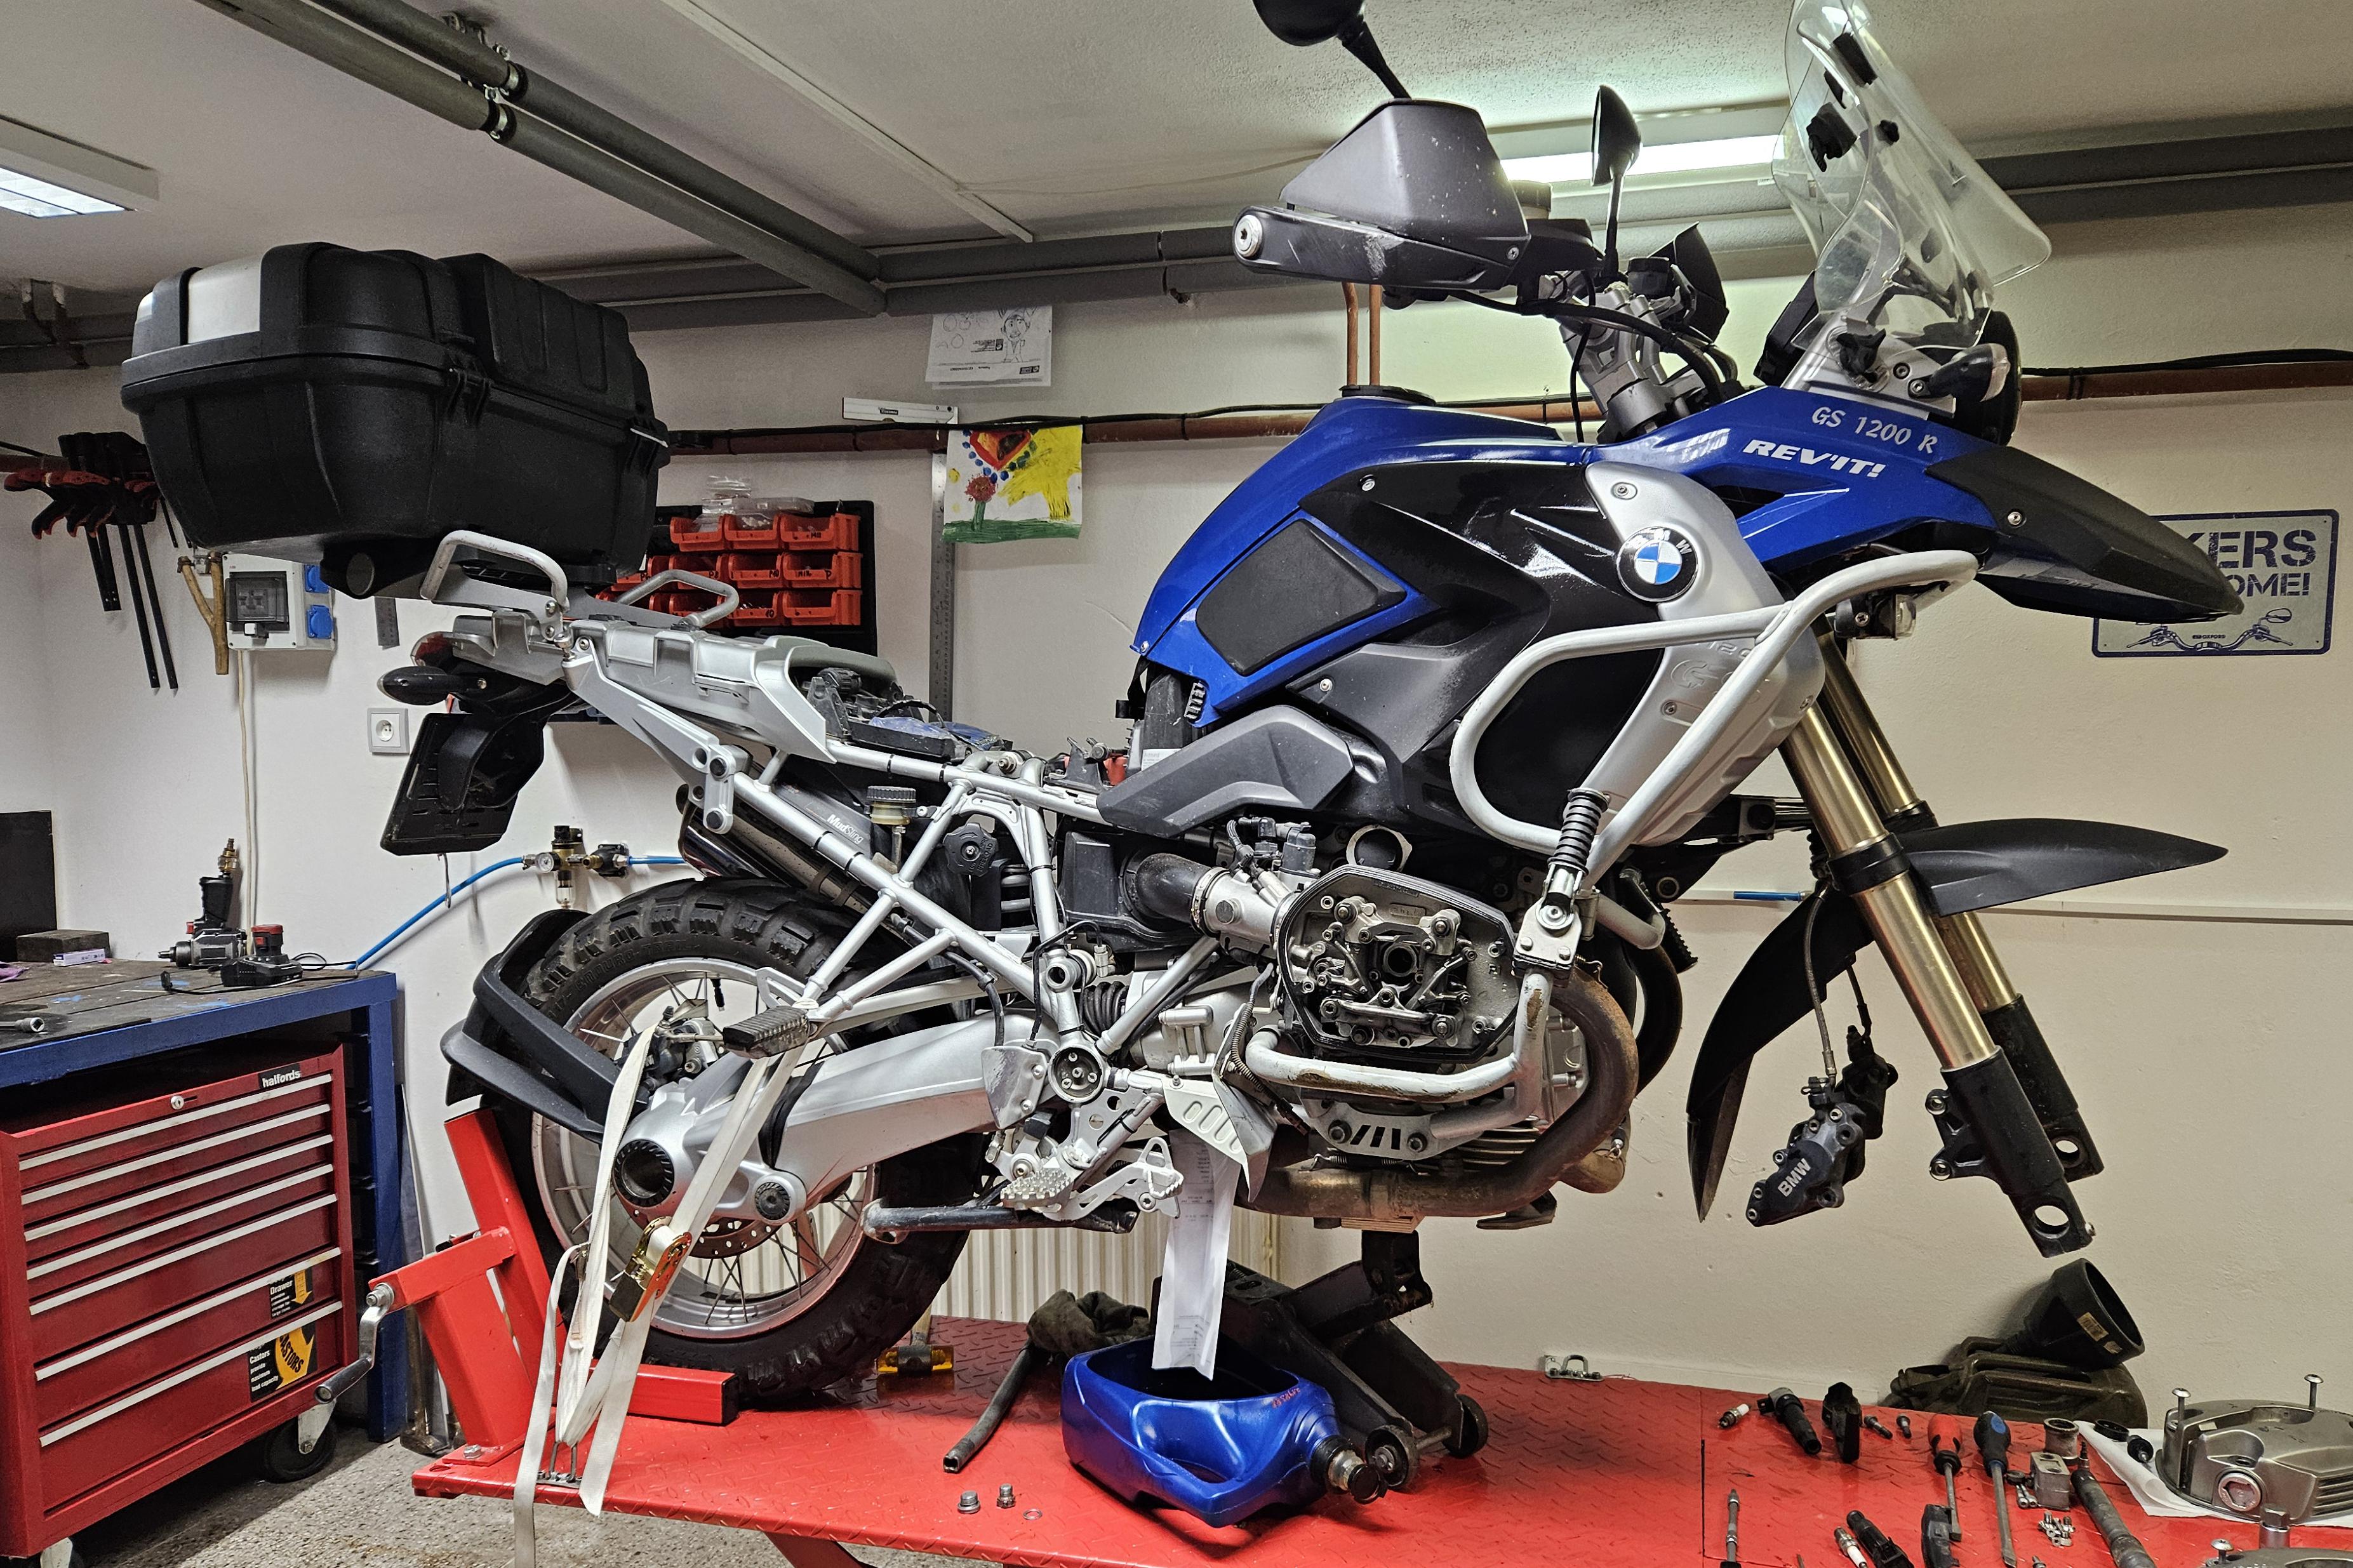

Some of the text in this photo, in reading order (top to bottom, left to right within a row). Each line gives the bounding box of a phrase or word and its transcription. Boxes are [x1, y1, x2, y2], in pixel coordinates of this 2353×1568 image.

[1812, 407, 1937, 454] GS 1200 R
[1743, 439, 1886, 478] REV'IT!
[2187, 529, 2317, 569] ERS
[827, 814, 864, 844] MudSling
[262, 1070, 302, 1088] halfords
[1778, 1158, 1811, 1197] BMW
[270, 1280, 293, 1296] Drawer
[250, 1350, 270, 1364] Castors
